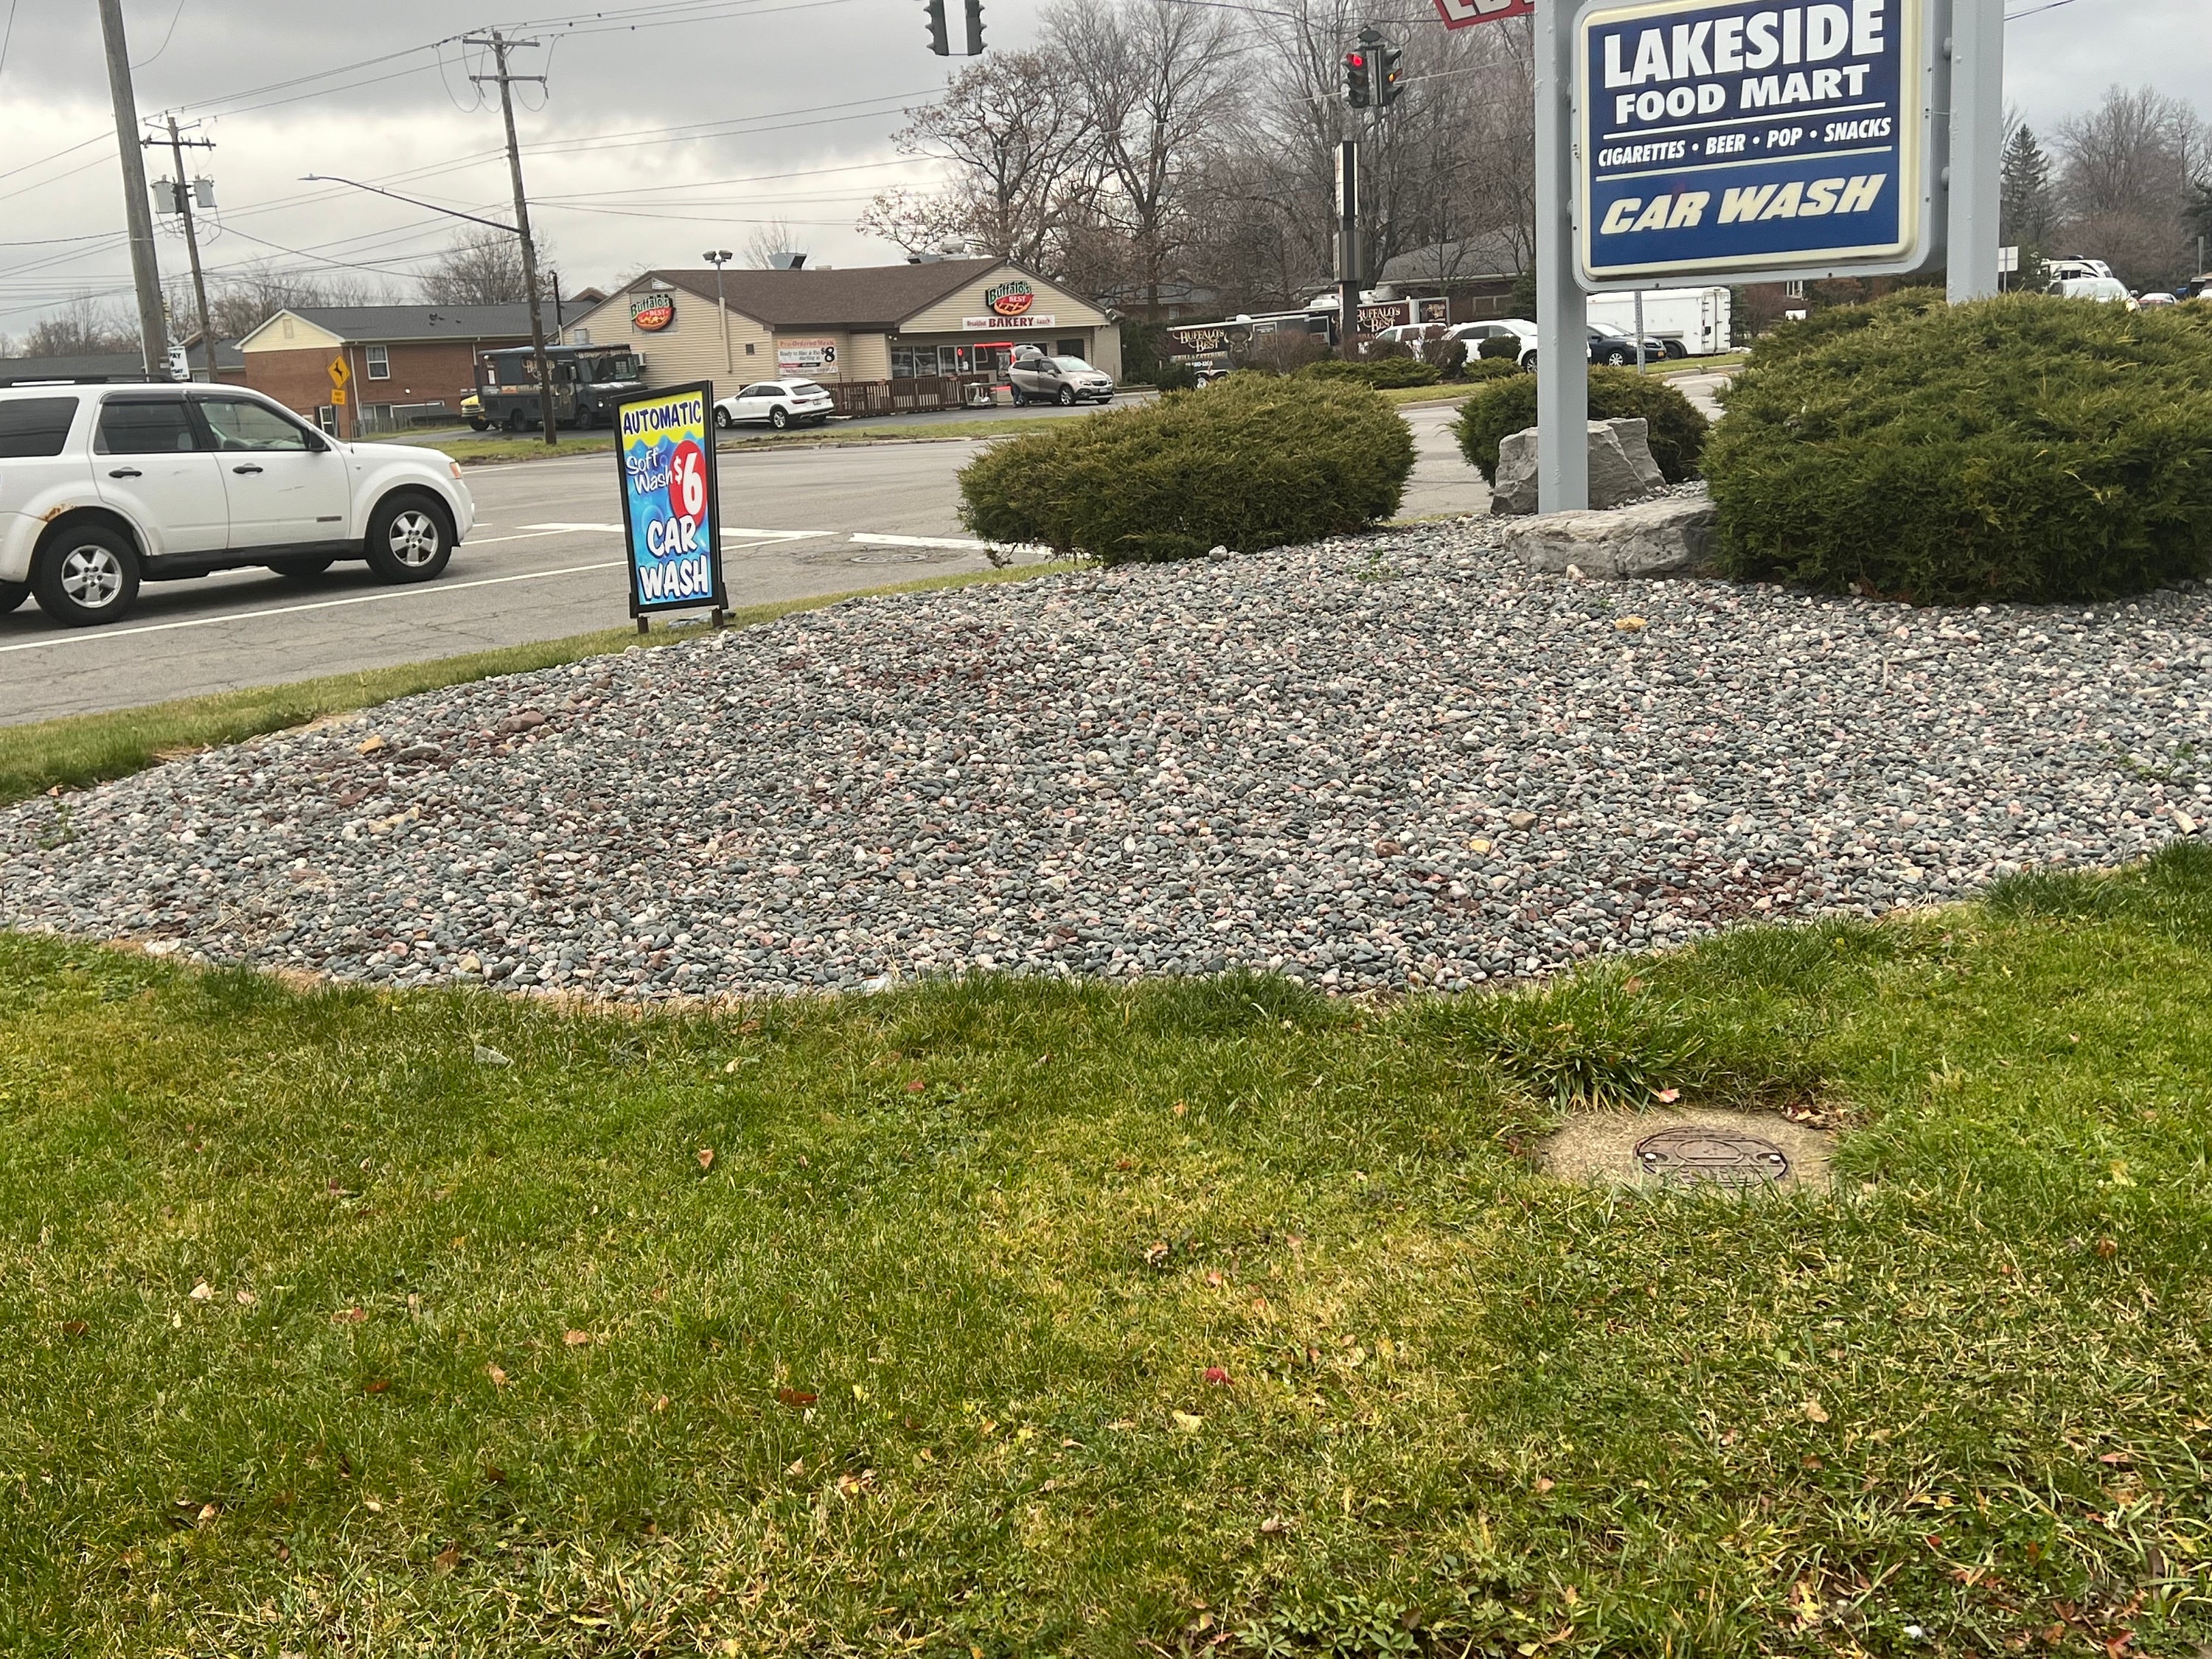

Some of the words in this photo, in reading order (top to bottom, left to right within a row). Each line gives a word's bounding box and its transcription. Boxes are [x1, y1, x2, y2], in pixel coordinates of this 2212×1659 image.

[1604, 0, 1884, 88] LAKESIDE
[1615, 84, 1725, 124] FOOD
[1740, 64, 1870, 109] MART
[1599, 140, 1685, 167] CIGARETTES
[1705, 134, 1746, 155] BEER
[1767, 128, 1803, 147] POP
[1824, 117, 1891, 142] SNACKS
[1600, 191, 1711, 234] CAR
[1717, 173, 1887, 224] WASH
[630, 296, 669, 320] Buffalo's
[989, 281, 1032, 305] Buffalo's
[989, 317, 1034, 327] BAKERY
[1173, 329, 1224, 344] BUFFALO'S
[821, 347, 835, 362] $8
[1189, 340, 1220, 352] BEST
[624, 400, 701, 434] AUTOMATIC
[627, 448, 658, 474] Soft
[634, 467, 672, 495] Wash
[674, 452, 703, 515] $6
[647, 515, 698, 557] CAR
[639, 554, 708, 601] WASH
